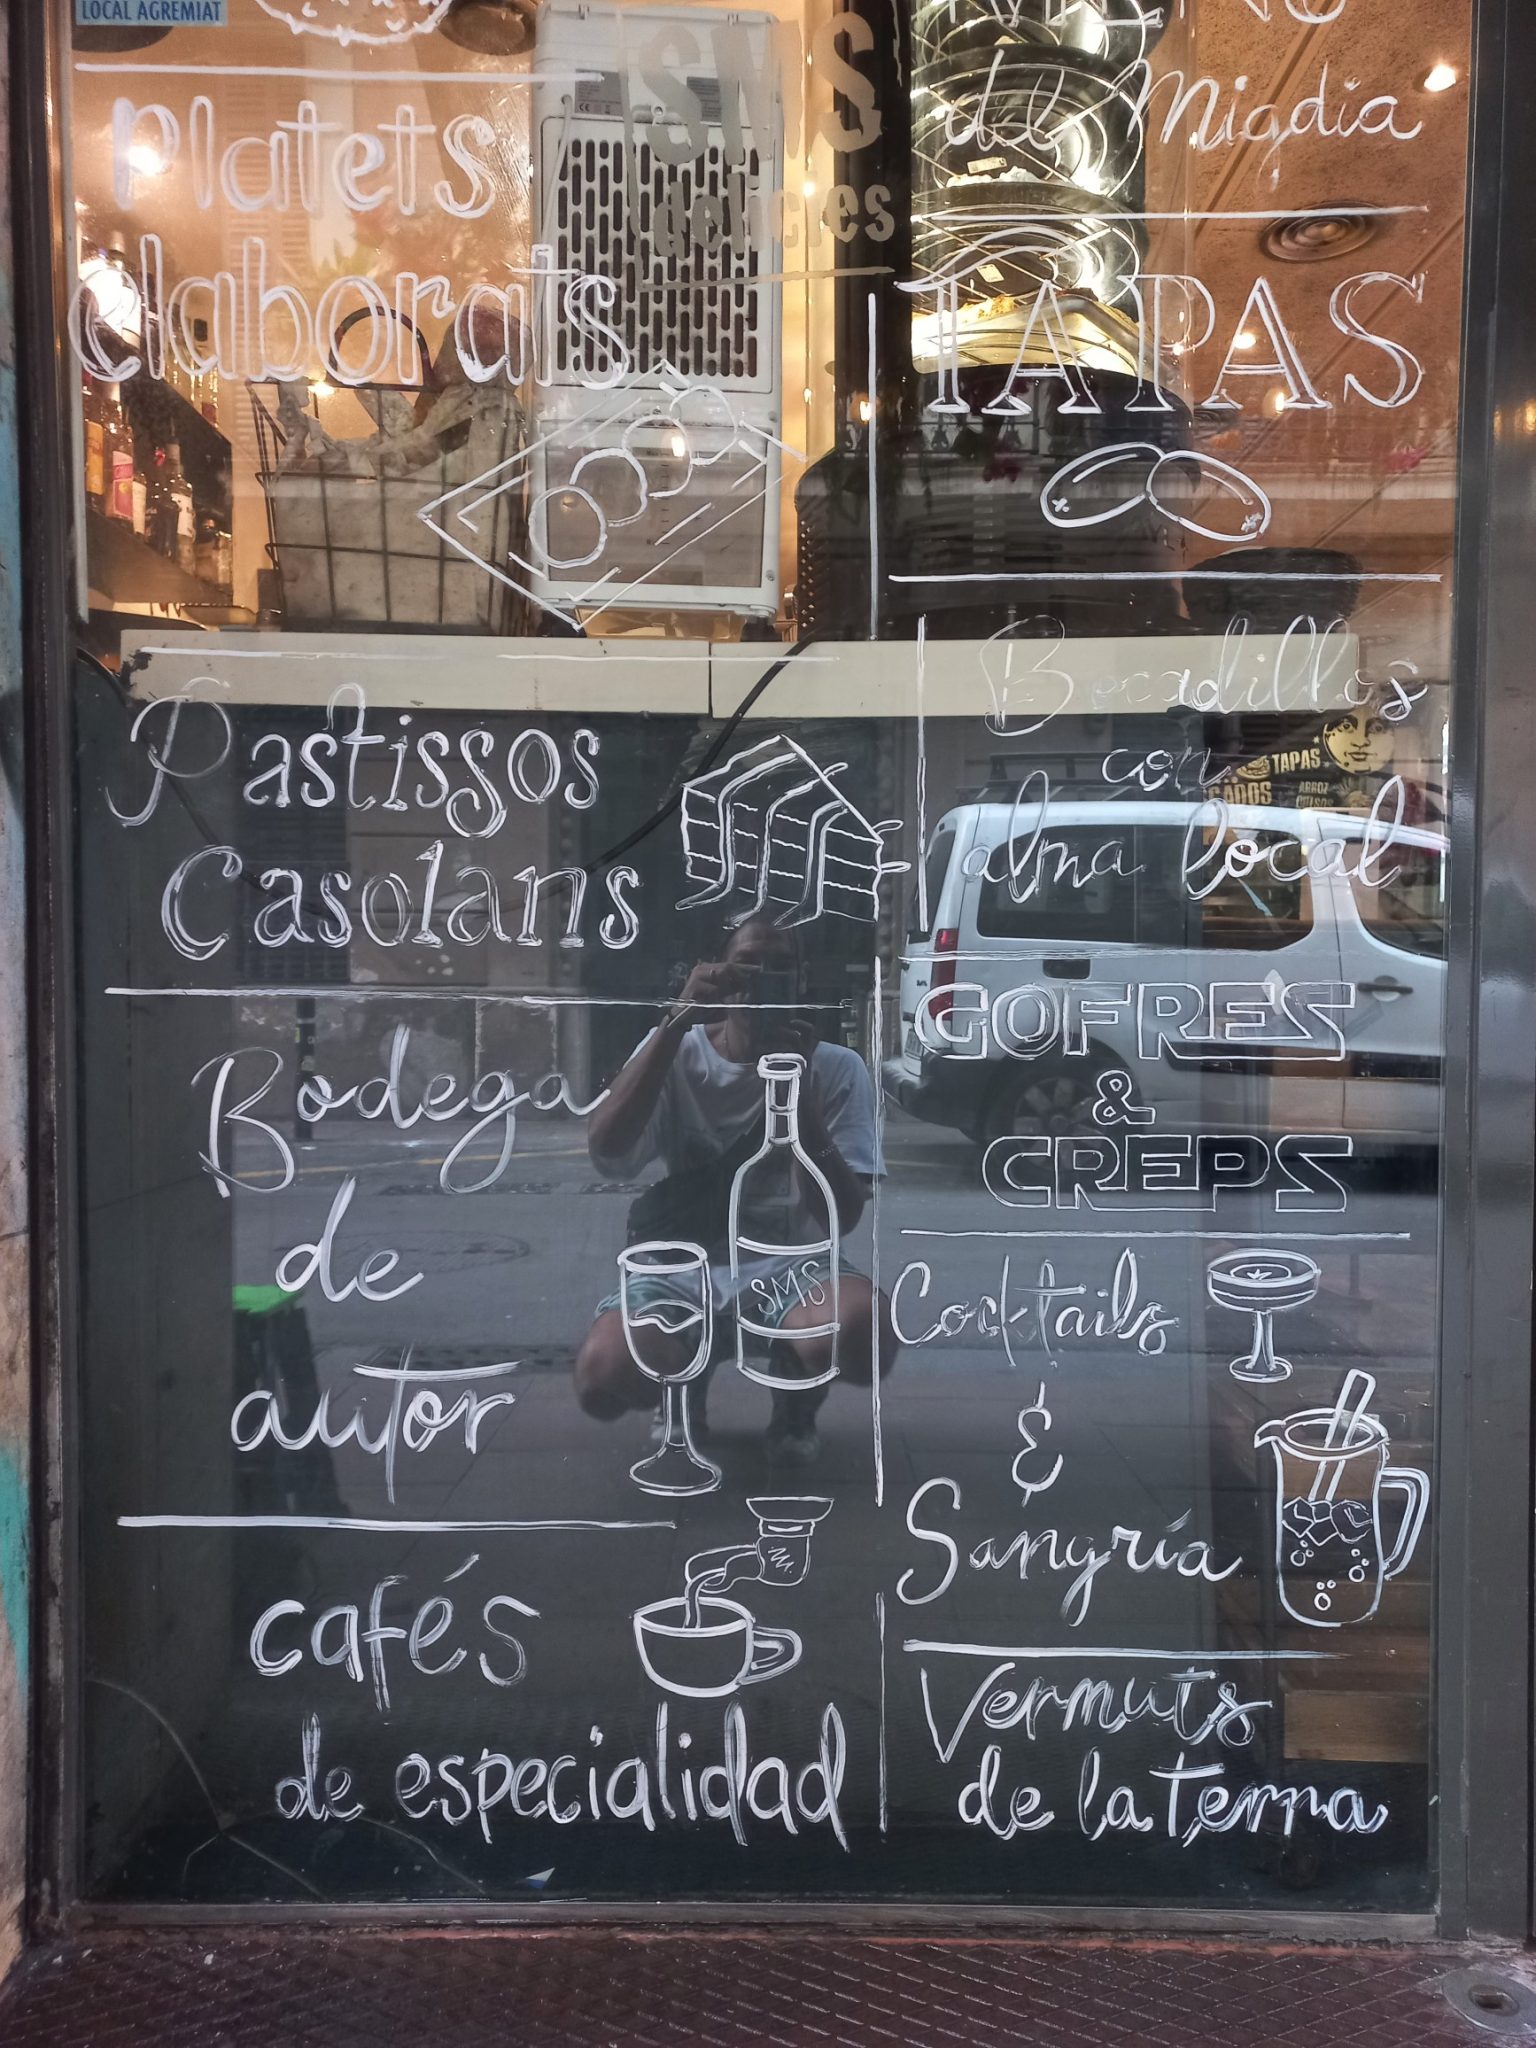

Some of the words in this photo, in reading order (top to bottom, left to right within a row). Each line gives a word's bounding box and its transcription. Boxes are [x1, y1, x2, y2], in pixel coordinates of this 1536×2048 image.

[82, 0, 132, 20] LOCAL
[137, 0, 222, 21] AGREMIAT
[894, 226, 1427, 414] TAPAS
[104, 677, 601, 839] Pastissos
[1102, 747, 1232, 795] con
[1272, 748, 1322, 775] TAPAS
[1182, 773, 1402, 901] local
[161, 840, 643, 961] Casolans
[914, 980, 1357, 1062] GOFRES
[190, 1024, 612, 1198] Bodega
[1092, 1070, 1156, 1125] &
[982, 1134, 1354, 1213] CREPS
[275, 1174, 425, 1303] de
[750, 1260, 826, 1316] SMS
[889, 1246, 1182, 1368] Cocktails
[229, 1346, 524, 1504] autor
[896, 1477, 1244, 1628] Sangría
[248, 1553, 541, 1713] cafés
[920, 1662, 1274, 1764] Vermuts
[273, 1712, 366, 1824] de
[394, 1700, 851, 1854] especialidad
[957, 1744, 1055, 1841] de
[1080, 1746, 1154, 1842] la
